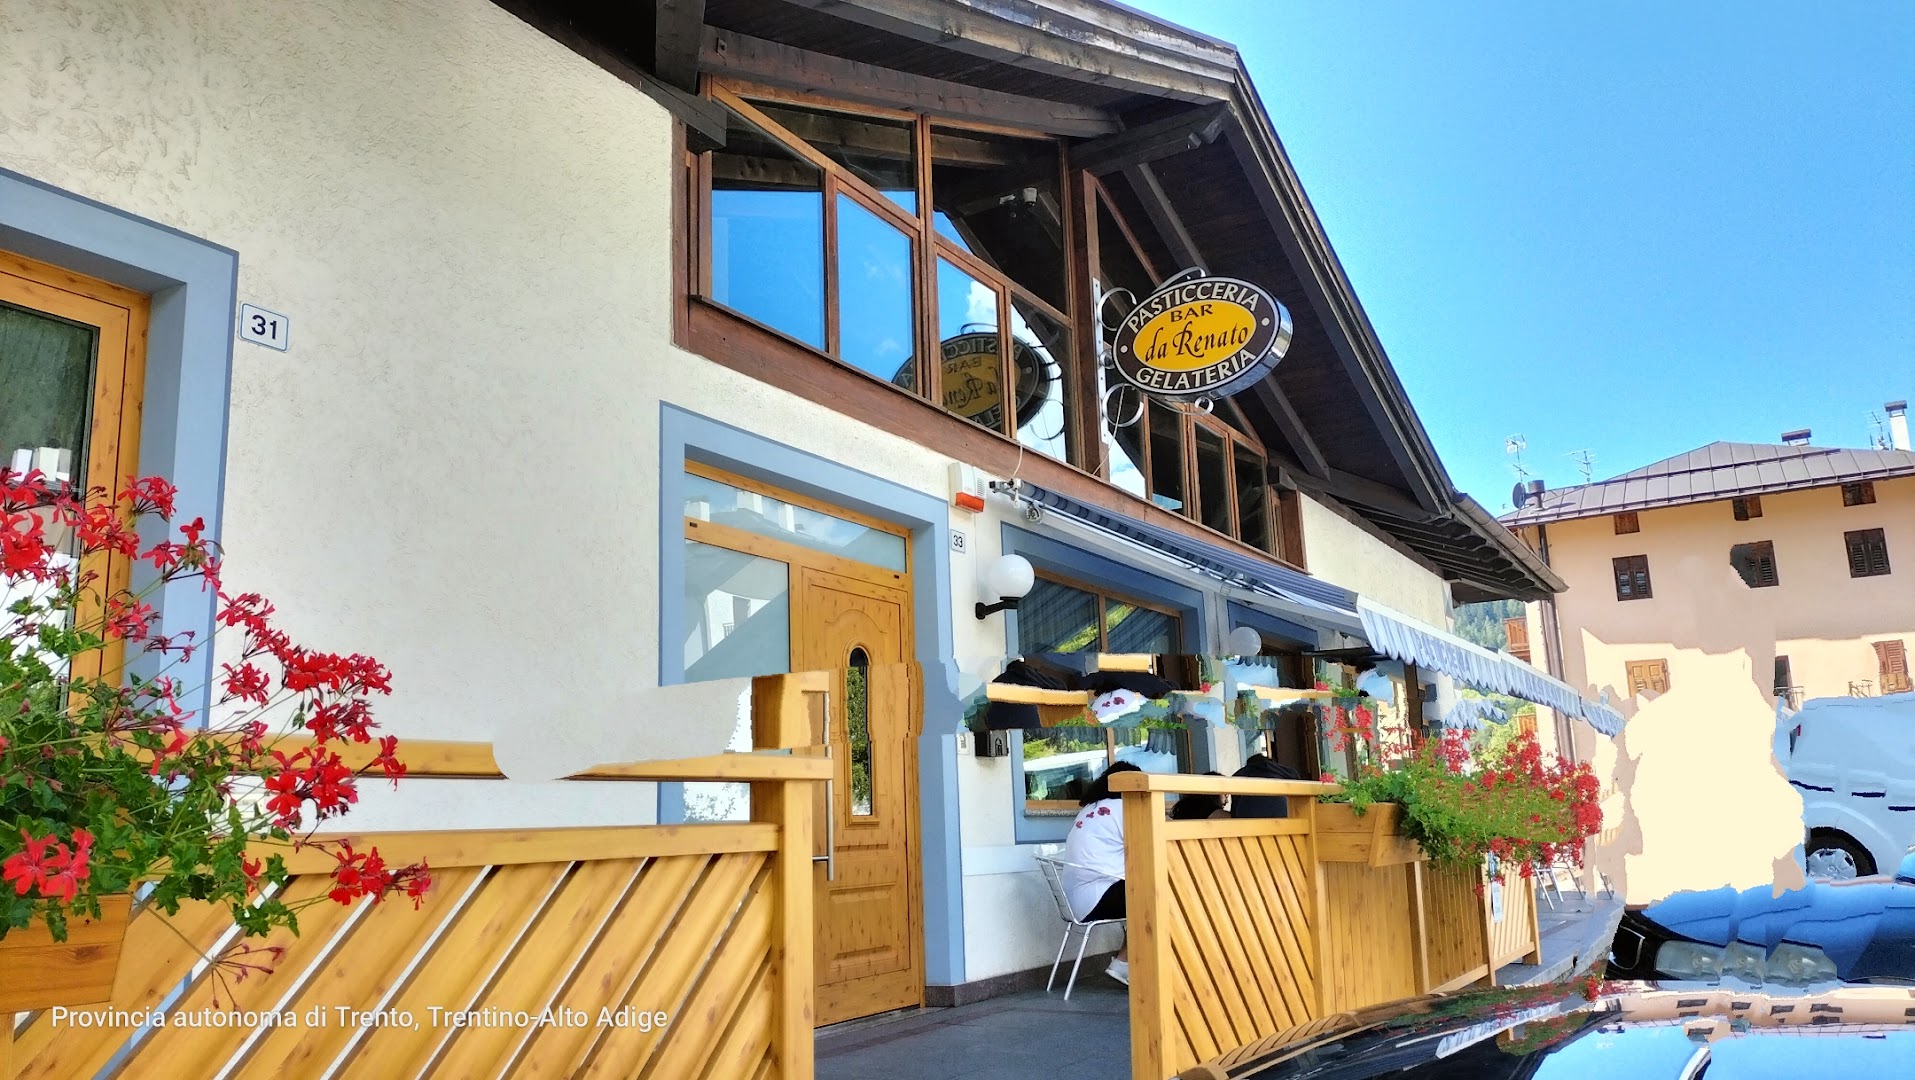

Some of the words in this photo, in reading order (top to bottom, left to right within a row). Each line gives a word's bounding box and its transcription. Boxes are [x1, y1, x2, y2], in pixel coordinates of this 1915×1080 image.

[1127, 282, 1260, 333] PASTICCERIA
[1170, 304, 1213, 323] BAR
[251, 314, 277, 340] 31
[1145, 327, 1168, 362] da
[1172, 321, 1249, 358] Renato
[1136, 350, 1256, 390] GELATERIA
[953, 534, 963, 548] 33
